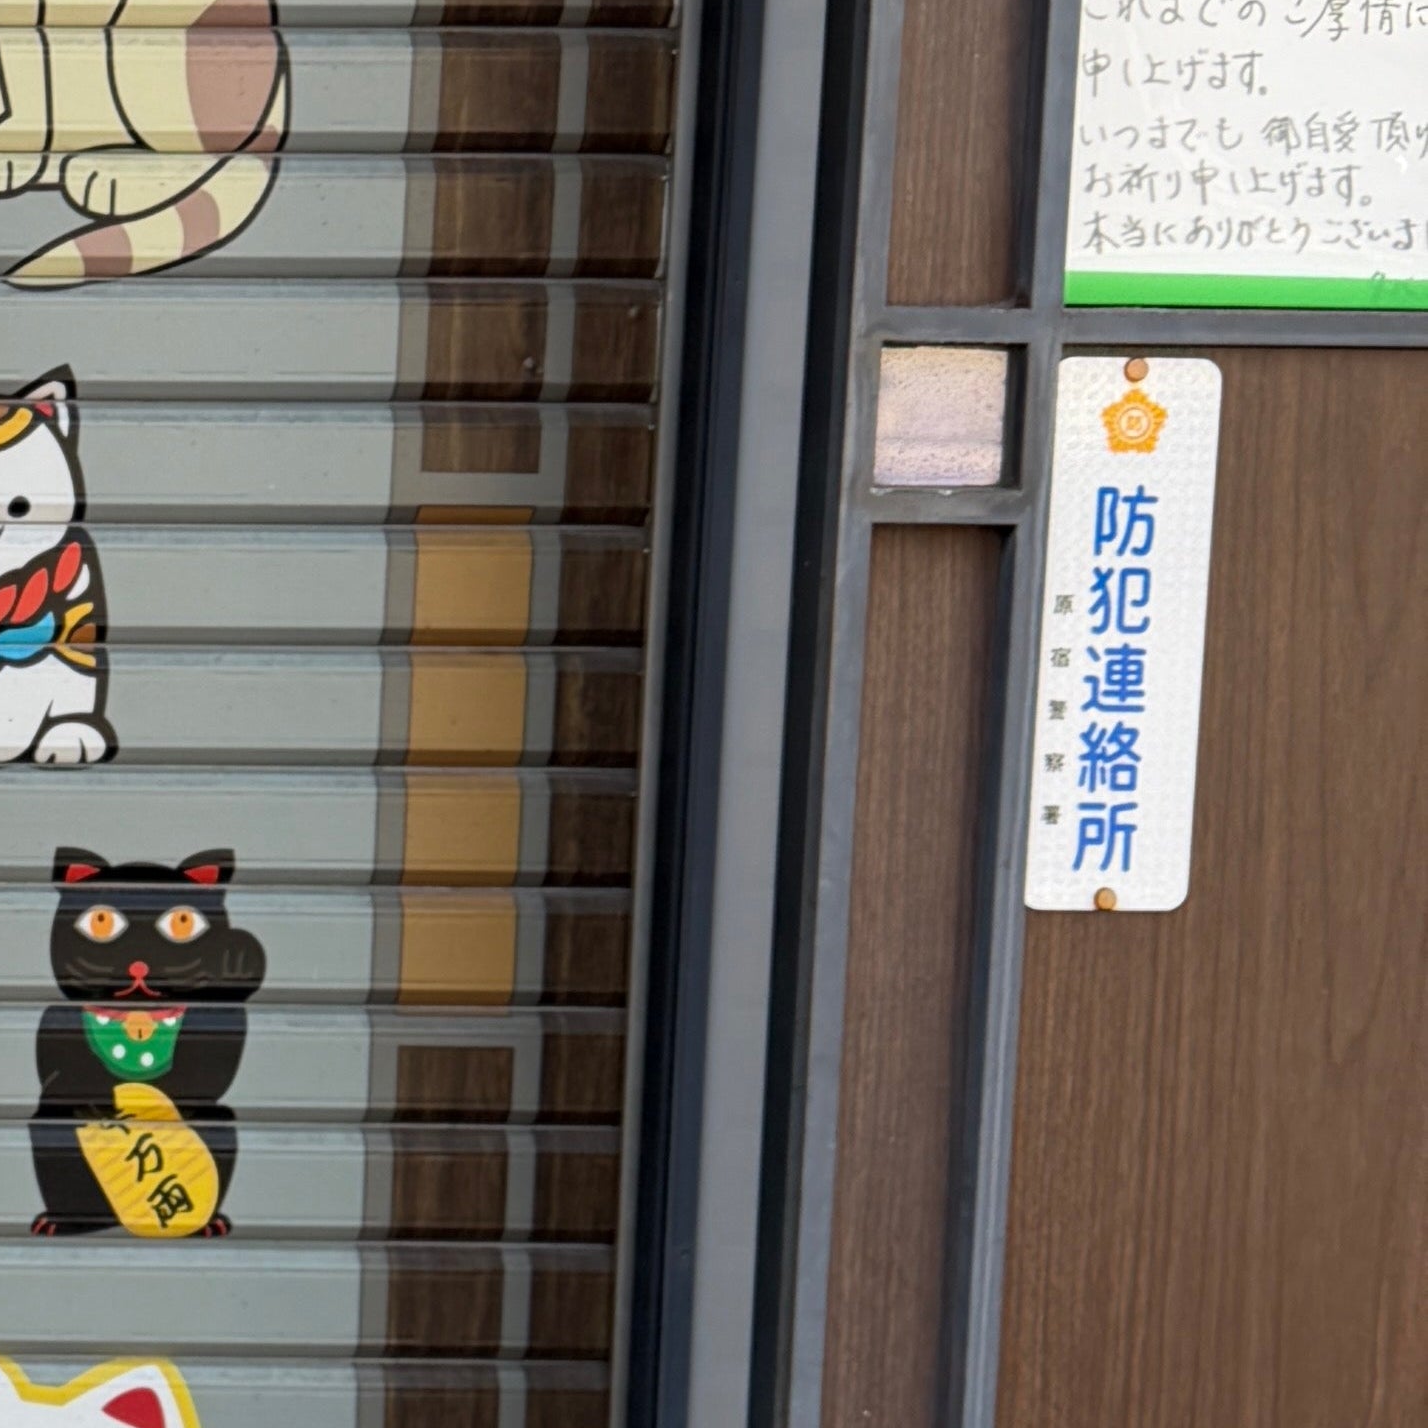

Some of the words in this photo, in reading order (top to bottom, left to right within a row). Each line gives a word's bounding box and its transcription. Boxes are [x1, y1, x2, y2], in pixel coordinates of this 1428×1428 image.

[1082, 209, 1428, 255] 本当にありがとうございま
[1072, 484, 1159, 872] 防犯連絡所
